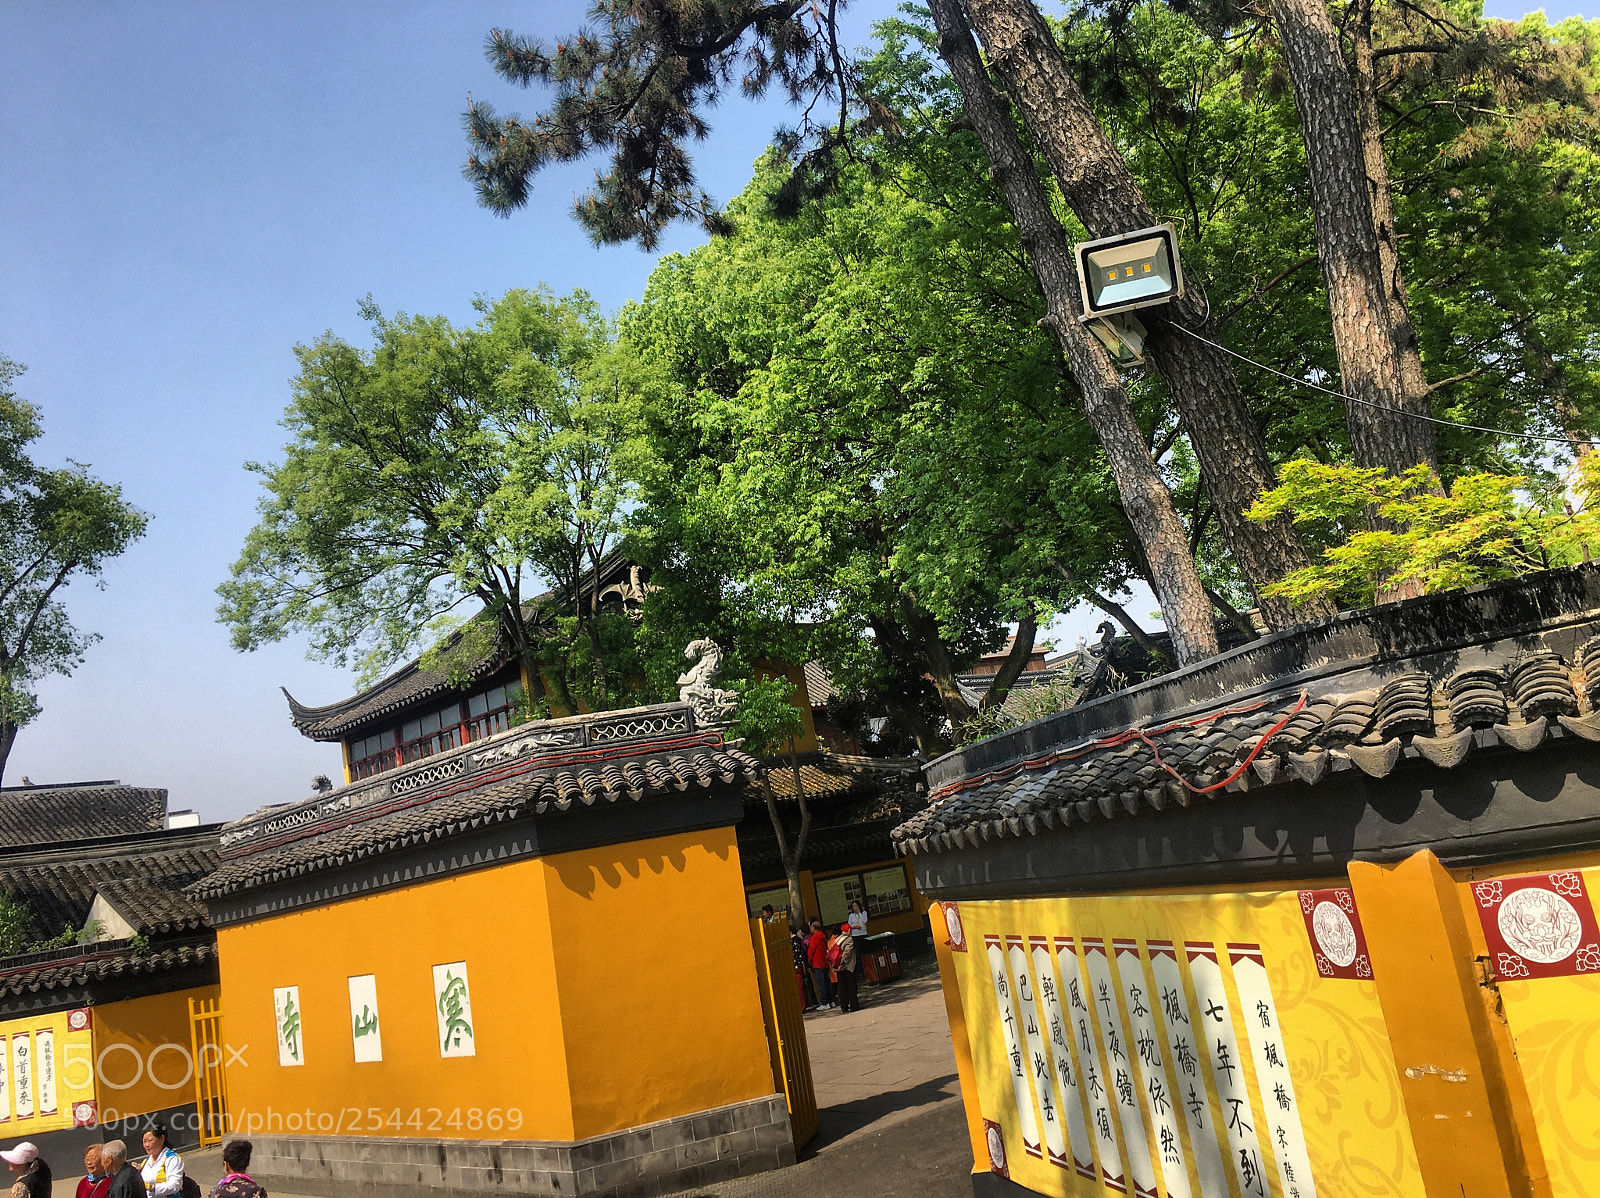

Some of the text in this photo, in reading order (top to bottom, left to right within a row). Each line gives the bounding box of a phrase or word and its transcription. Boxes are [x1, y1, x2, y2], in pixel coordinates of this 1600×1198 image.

[283, 991, 299, 1061] 寺
[355, 1004, 377, 1038] 山
[439, 969, 473, 1052] 寒
[997, 970, 1023, 1077] 尚千重
[1019, 974, 1054, 1122] 巴山此去
[1041, 973, 1076, 1088] 輕感慨
[1069, 978, 1113, 1143] 風月未須
[1098, 979, 1135, 1107] 半夜鐘
[1162, 985, 1205, 1129] 楓橋寺
[1256, 1000, 1291, 1111] 宿楓橋
[1130, 984, 1180, 1164] 客枕依然
[1205, 999, 1264, 1198] 七年不到
